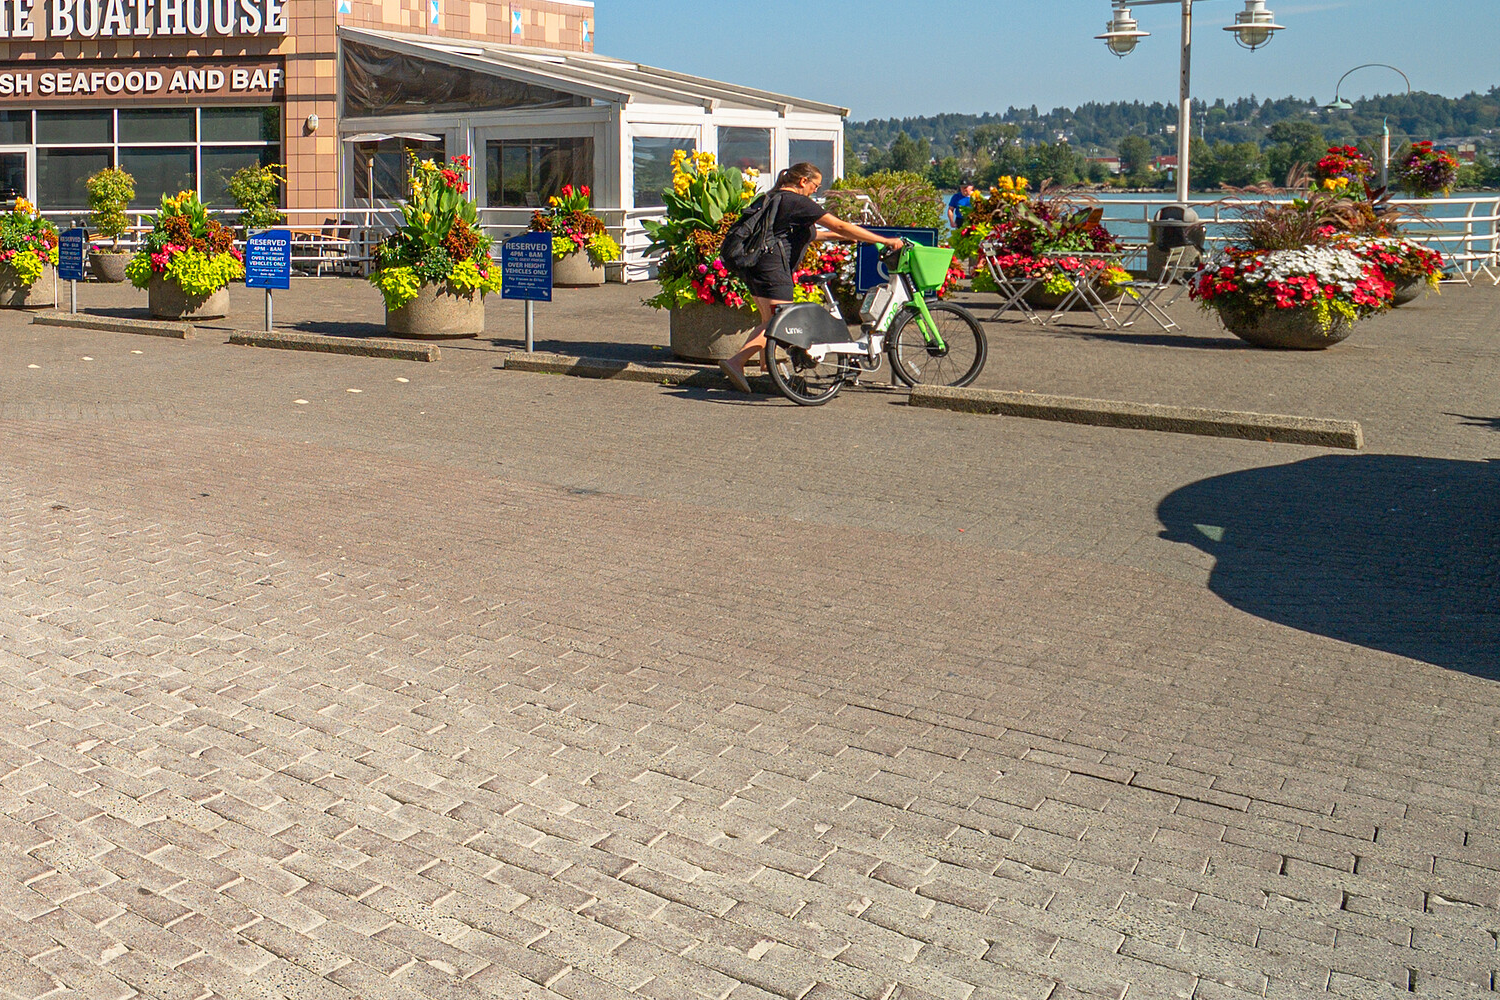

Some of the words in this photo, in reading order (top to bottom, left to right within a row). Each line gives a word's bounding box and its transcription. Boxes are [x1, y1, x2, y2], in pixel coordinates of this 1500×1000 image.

[40, 71, 163, 93] SEAFOOD
[169, 69, 225, 90] AND
[232, 68, 285, 89] BAR
[505, 243, 547, 251] RESERVED
[879, 302, 898, 332] ime
